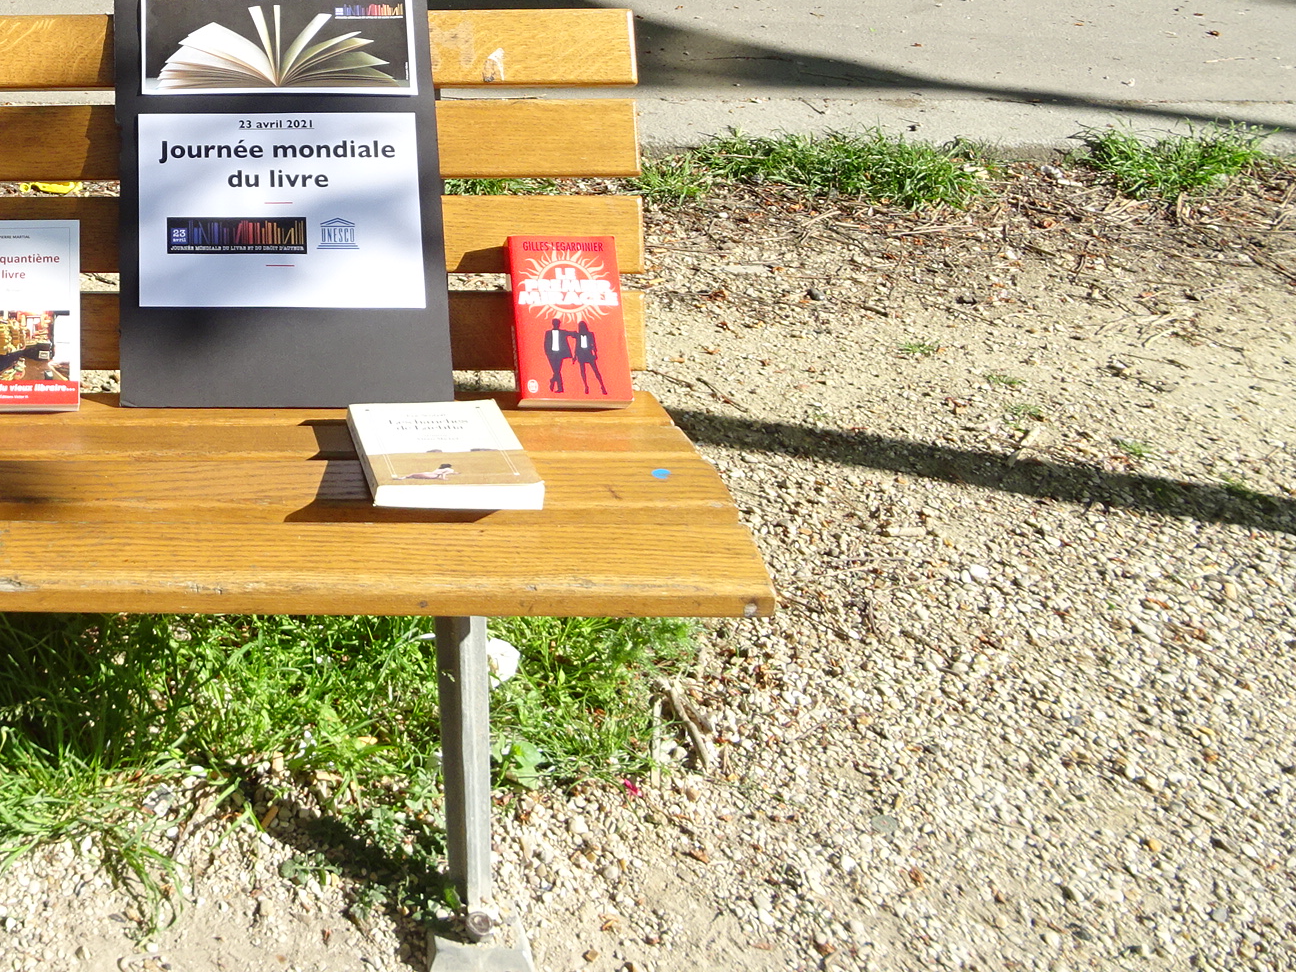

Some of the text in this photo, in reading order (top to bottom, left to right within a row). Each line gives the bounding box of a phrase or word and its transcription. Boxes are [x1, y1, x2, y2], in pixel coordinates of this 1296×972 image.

[238, 119, 314, 129] 23 avril 2021
[159, 139, 396, 164] Journée mondiale
[227, 169, 330, 188] du livre
[172, 229, 186, 237] 23
[321, 227, 355, 243] UNESCO
[522, 241, 604, 252] GILLES LEGARDINIER
[1, 270, 26, 279] livre
[554, 267, 576, 280] LE
[524, 278, 611, 293] PREMIER
[518, 290, 619, 306] MIRACLE
[9, 384, 33, 392] vieux
